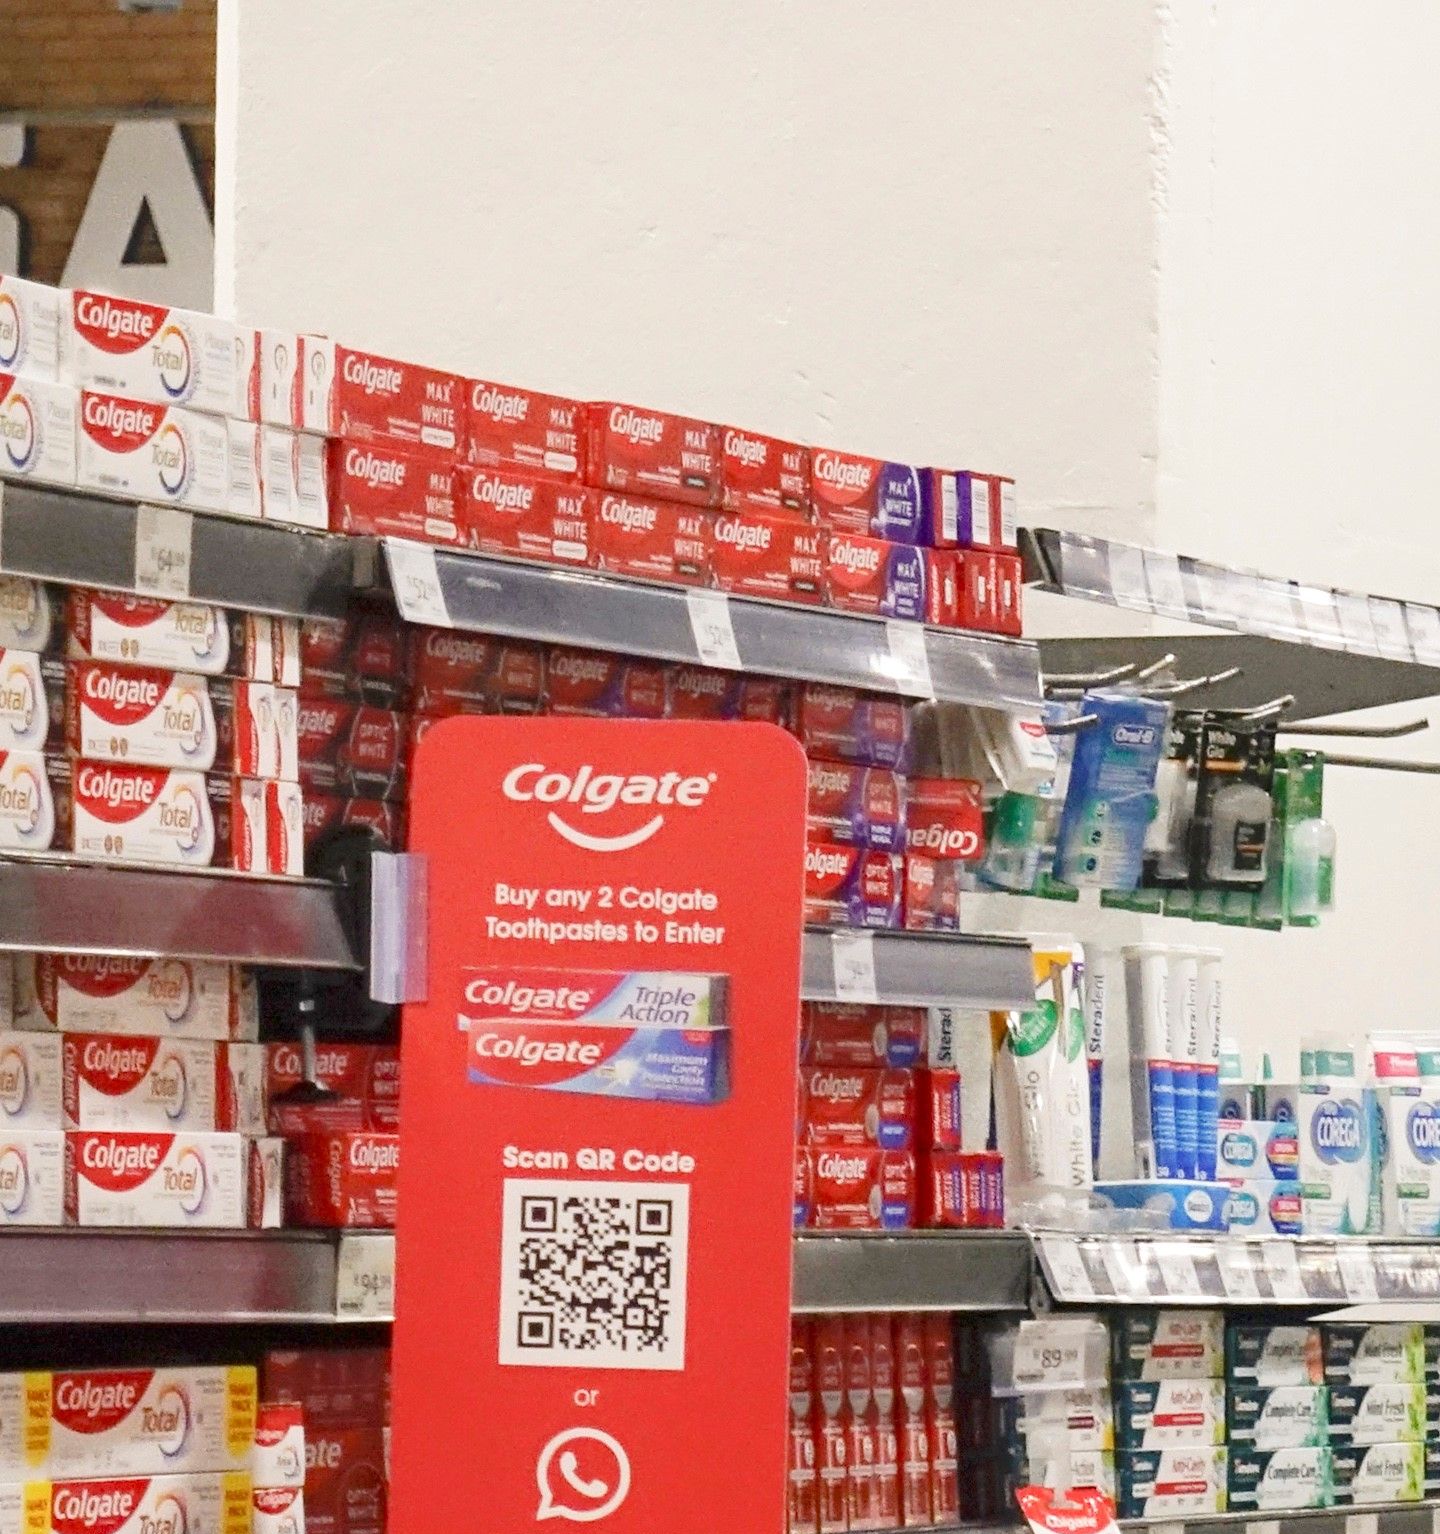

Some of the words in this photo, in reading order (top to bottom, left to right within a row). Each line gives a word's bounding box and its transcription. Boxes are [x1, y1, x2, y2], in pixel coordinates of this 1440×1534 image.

[76, 296, 154, 355] Colgate
[151, 341, 185, 375] Total
[344, 354, 401, 396] Colgate
[425, 379, 451, 402] MAX
[471, 382, 529, 421] Colgate
[82, 394, 155, 439] Colgate
[421, 405, 455, 429] WHITE
[609, 405, 662, 444] Colgate
[151, 442, 181, 476] Total
[724, 430, 767, 465] Colgate
[346, 449, 406, 486] Colgate
[814, 452, 871, 491] Colgate
[471, 472, 532, 512] Colgate
[556, 495, 585, 518] MAX
[552, 516, 588, 541] WHITE
[600, 495, 656, 532] Colgate
[714, 516, 771, 550] Colgate
[829, 536, 879, 571] Colgate
[85, 669, 158, 709] Colgate
[162, 706, 195, 731] Total
[78, 768, 154, 806] Colgate
[502, 763, 710, 813] Colgate
[159, 801, 191, 828] Total
[495, 883, 539, 910] Buy
[546, 887, 591, 913] any
[599, 887, 612, 907] 2
[619, 887, 718, 914] Colgate
[486, 916, 628, 945] Toothpastes
[635, 922, 658, 942] to
[666, 922, 724, 945] Enter
[464, 979, 590, 1016] Colgate
[619, 1004, 689, 1024] Action
[634, 987, 696, 1007] Triple
[1090, 975, 1104, 1053] Steradent
[1187, 976, 1197, 1056] Steradent
[83, 1042, 146, 1078] Colgate
[475, 1033, 601, 1066] Colgate
[809, 1074, 863, 1103] Colgate
[1317, 1118, 1361, 1147] COREGA
[82, 1138, 159, 1174] Colgate
[503, 1146, 569, 1170] Scan
[577, 1149, 615, 1171] QR
[623, 1150, 695, 1174] Code
[818, 1152, 867, 1181] Colgate
[163, 1166, 198, 1191] Total
[56, 1380, 136, 1417] Colgate
[573, 1388, 599, 1407] or
[142, 1407, 178, 1432] Total
[53, 1489, 133, 1525] Colgate
